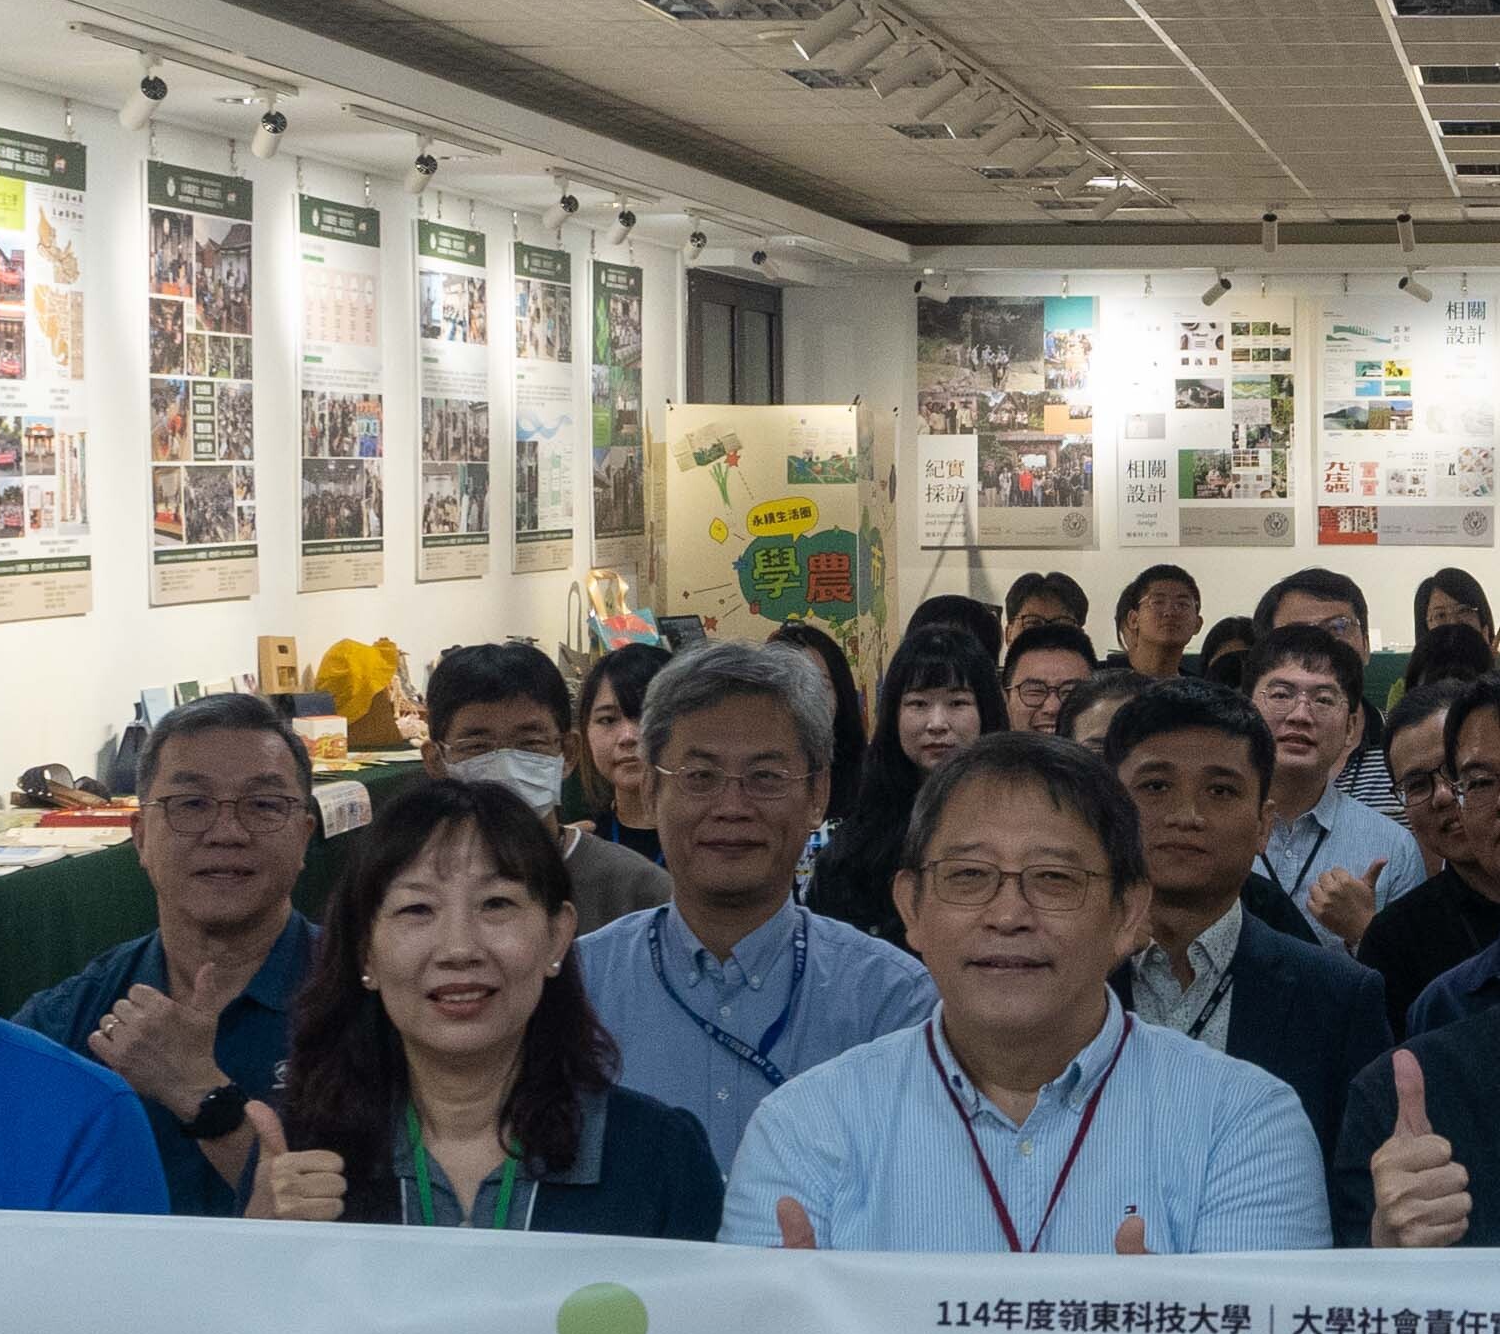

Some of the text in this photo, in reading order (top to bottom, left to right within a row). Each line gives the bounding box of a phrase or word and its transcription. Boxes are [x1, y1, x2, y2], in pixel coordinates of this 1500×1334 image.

[1445, 300, 1487, 320] 相關
[1445, 325, 1486, 345] 設計
[925, 459, 965, 479] 紀實
[1127, 459, 1167, 479] 相關
[925, 483, 965, 503] 採訪
[1127, 483, 1167, 503] 設計
